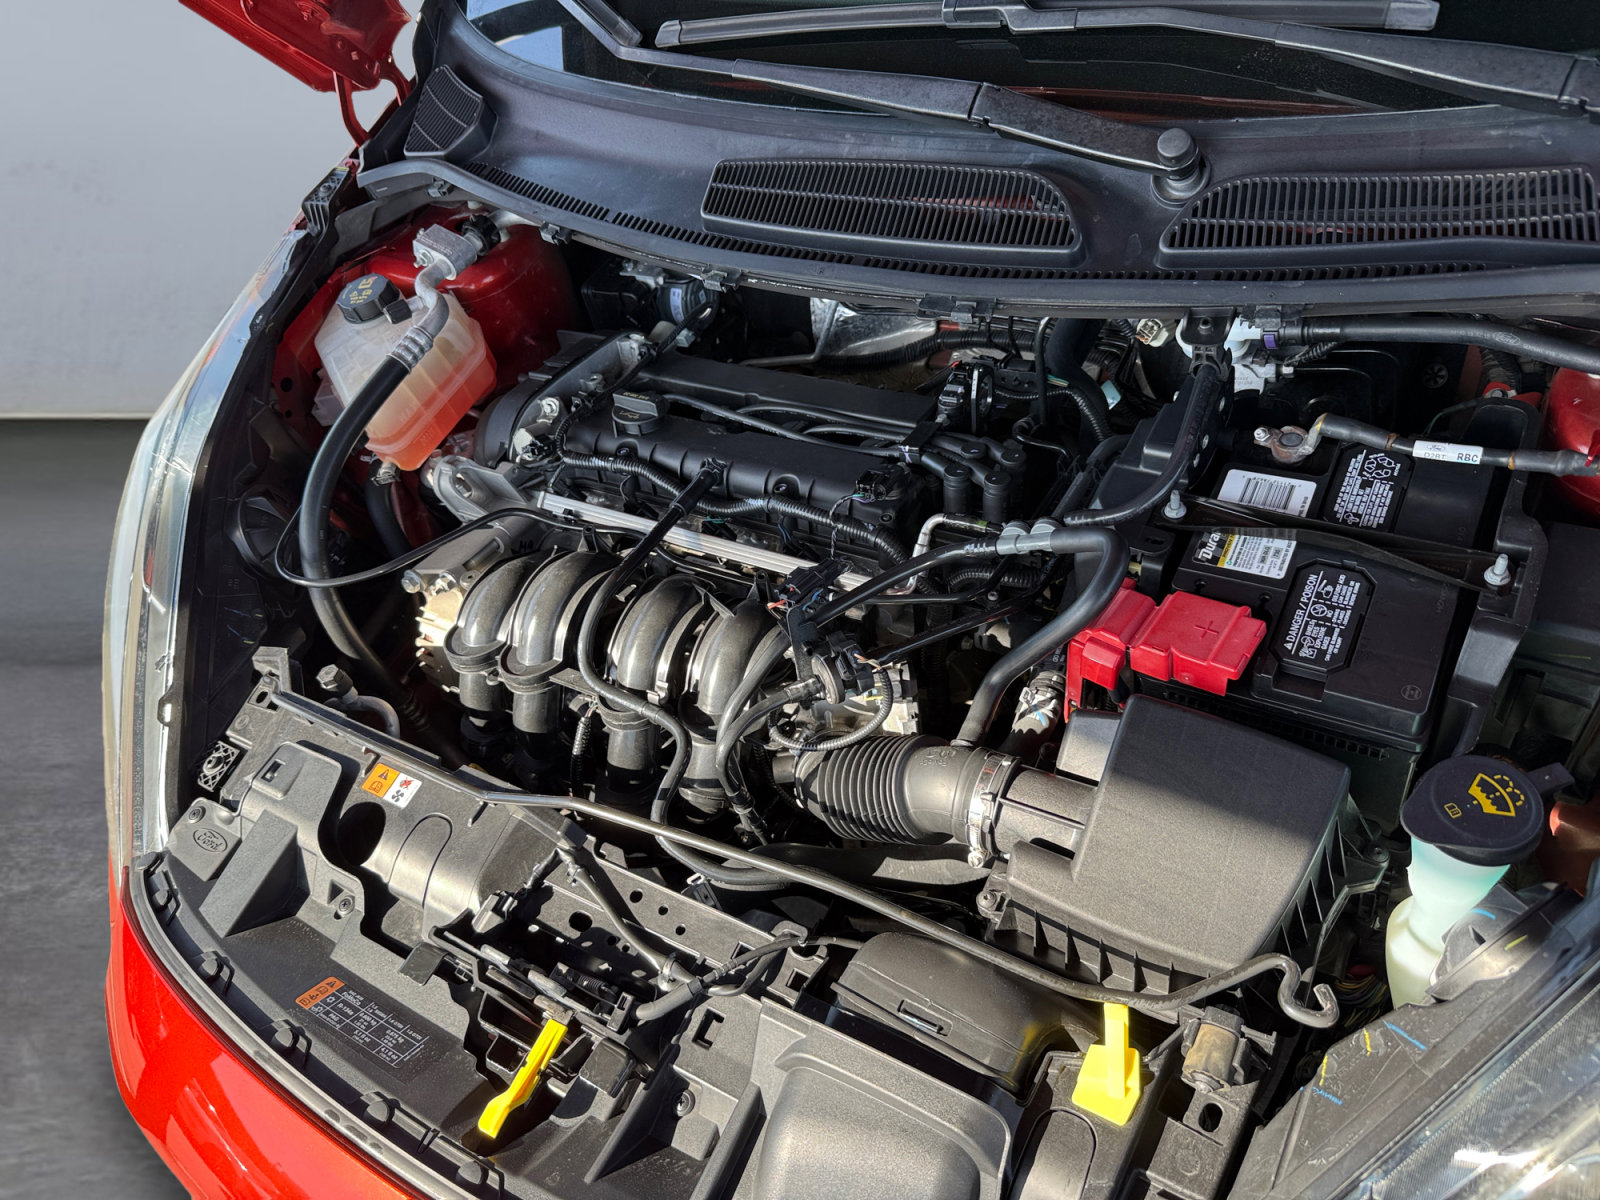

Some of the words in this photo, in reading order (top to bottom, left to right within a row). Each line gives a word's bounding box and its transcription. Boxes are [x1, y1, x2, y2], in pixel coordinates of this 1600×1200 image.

[1457, 453, 1479, 463] RBC
[1286, 609, 1305, 642] DANGER
[1300, 574, 1318, 602] POISON
[1326, 610, 1334, 618] NO
[1312, 626, 1320, 637] EYES
[196, 830, 224, 851] Ford
[336, 1002, 354, 1016] R-134a
